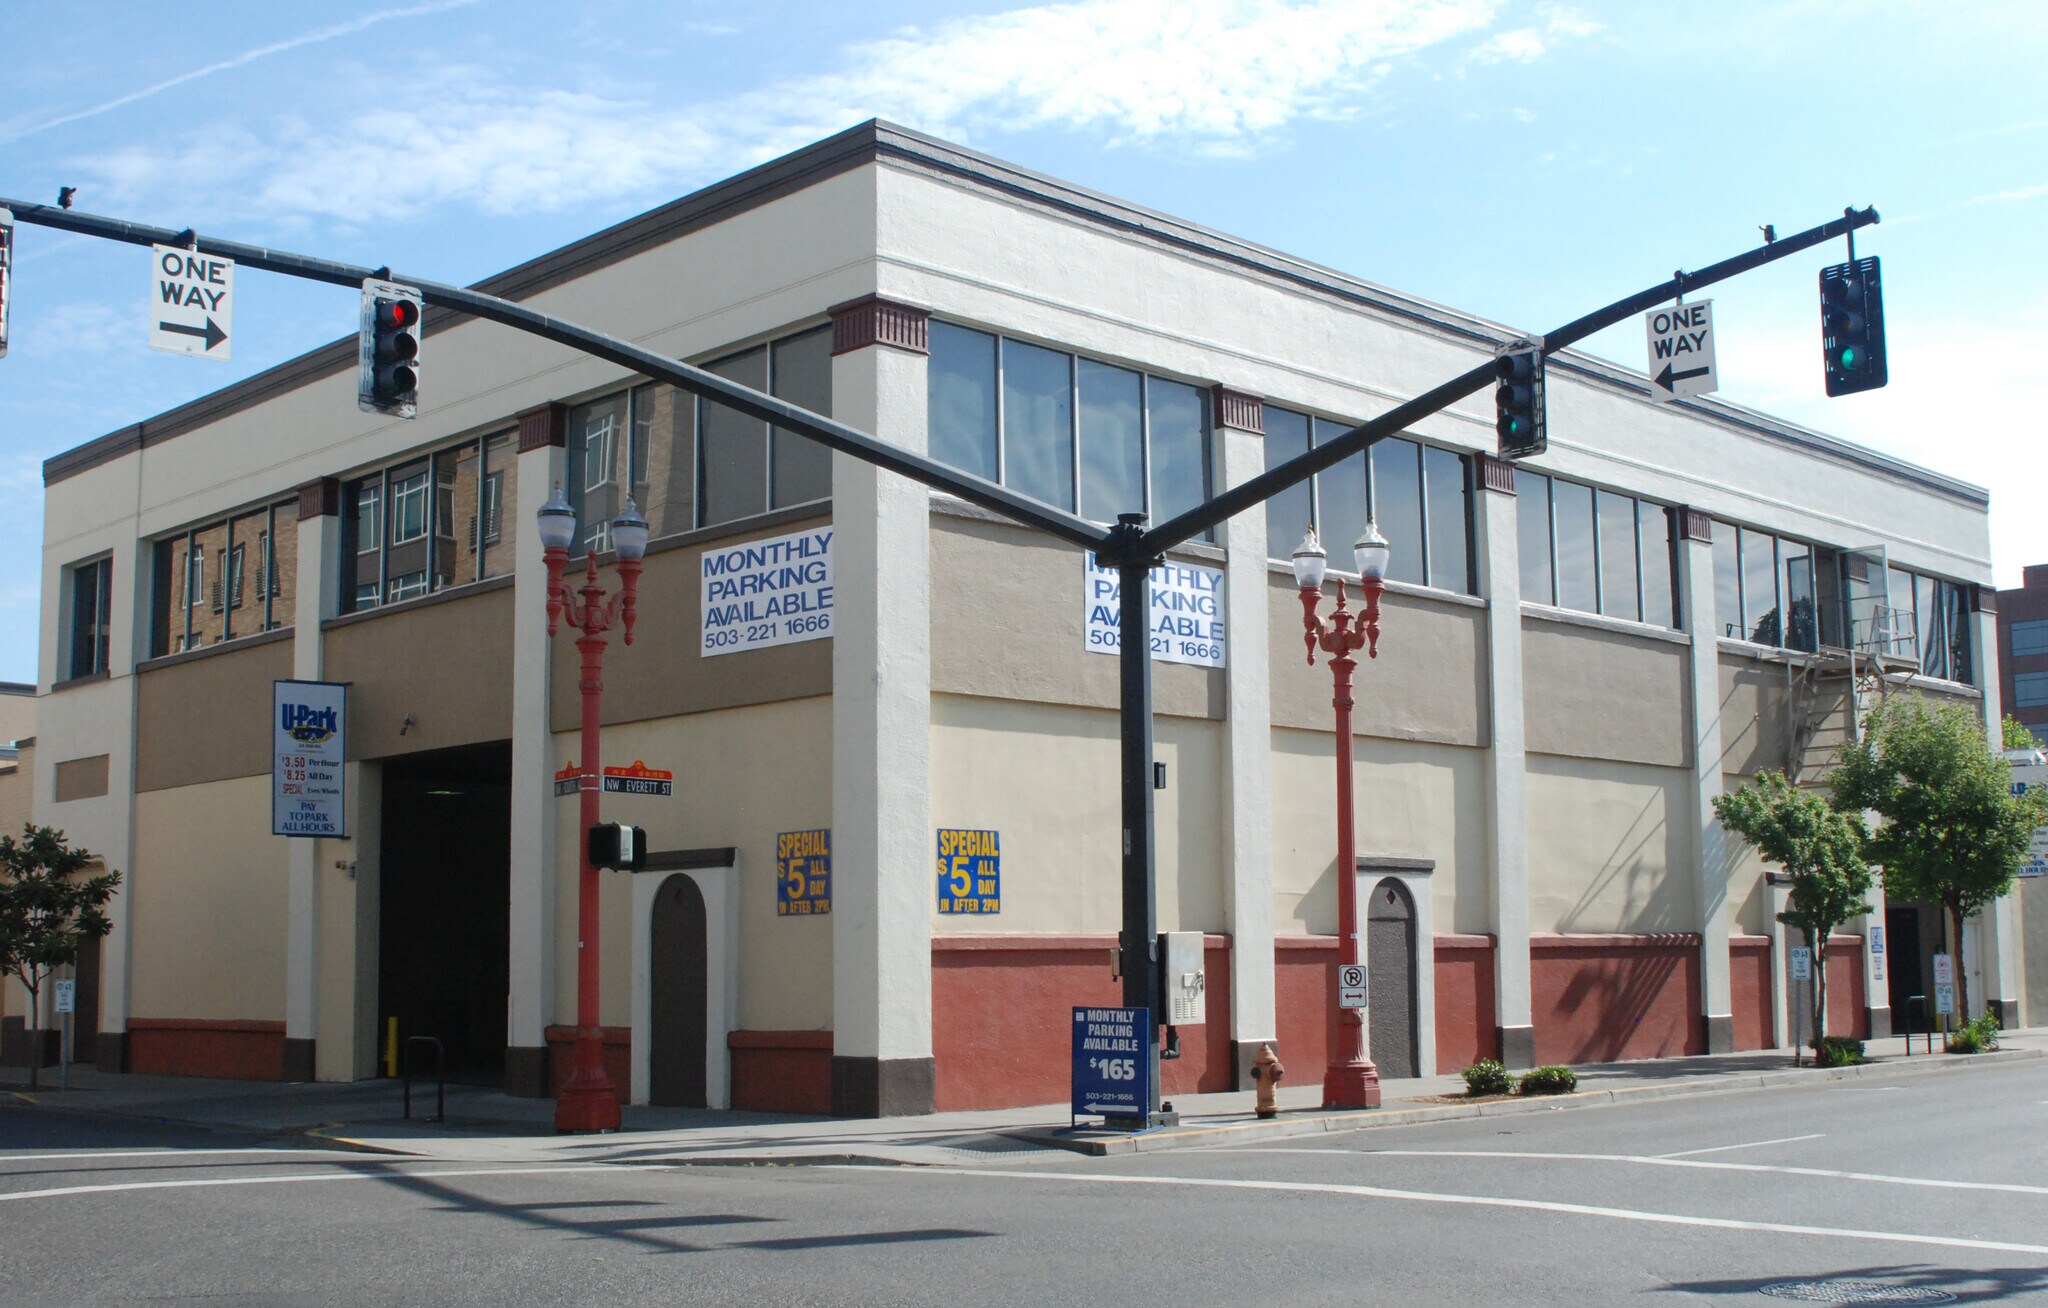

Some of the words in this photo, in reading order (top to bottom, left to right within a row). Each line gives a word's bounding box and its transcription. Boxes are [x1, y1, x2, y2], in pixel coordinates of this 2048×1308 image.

[162, 253, 226, 285] ONE
[160, 280, 226, 312] WAY
[1653, 305, 1706, 334] ONE
[1654, 330, 1707, 359] WAY
[704, 532, 833, 577] MONTHLY
[708, 561, 826, 602] PARKING
[705, 586, 833, 629] AVAILABLE
[784, 614, 829, 635] 1666
[1179, 642, 1220, 659] 1666
[282, 704, 337, 733] U-Park
[309, 759, 319, 767] Per
[319, 773, 333, 782] Day
[283, 784, 303, 794] SPECIAL
[606, 779, 619, 791] NW
[626, 780, 658, 793] EVERETT
[662, 782, 670, 794] ST
[301, 802, 316, 811] PAY
[289, 812, 304, 821] TO
[305, 813, 328, 822] PARK
[282, 822, 299, 831] ALL
[301, 823, 335, 832] HOURS
[779, 831, 828, 859] SPECIAL
[940, 830, 999, 856] SPECIAL
[810, 860, 827, 875] ALL
[978, 860, 996, 875] ALL
[810, 880, 826, 896] DAY
[978, 880, 995, 895] DAY
[789, 900, 811, 913] AFTER
[940, 899, 950, 911] IN
[954, 899, 978, 911] AFTER
[983, 899, 999, 911] 2PM
[1087, 1010, 1134, 1023] MONTHLY
[1088, 1024, 1133, 1037] PARKING
[1083, 1038, 1138, 1051] AVAILABLE
[1090, 1056, 1135, 1080] $165
[1086, 1092, 1134, 1101] 503-221-1666
